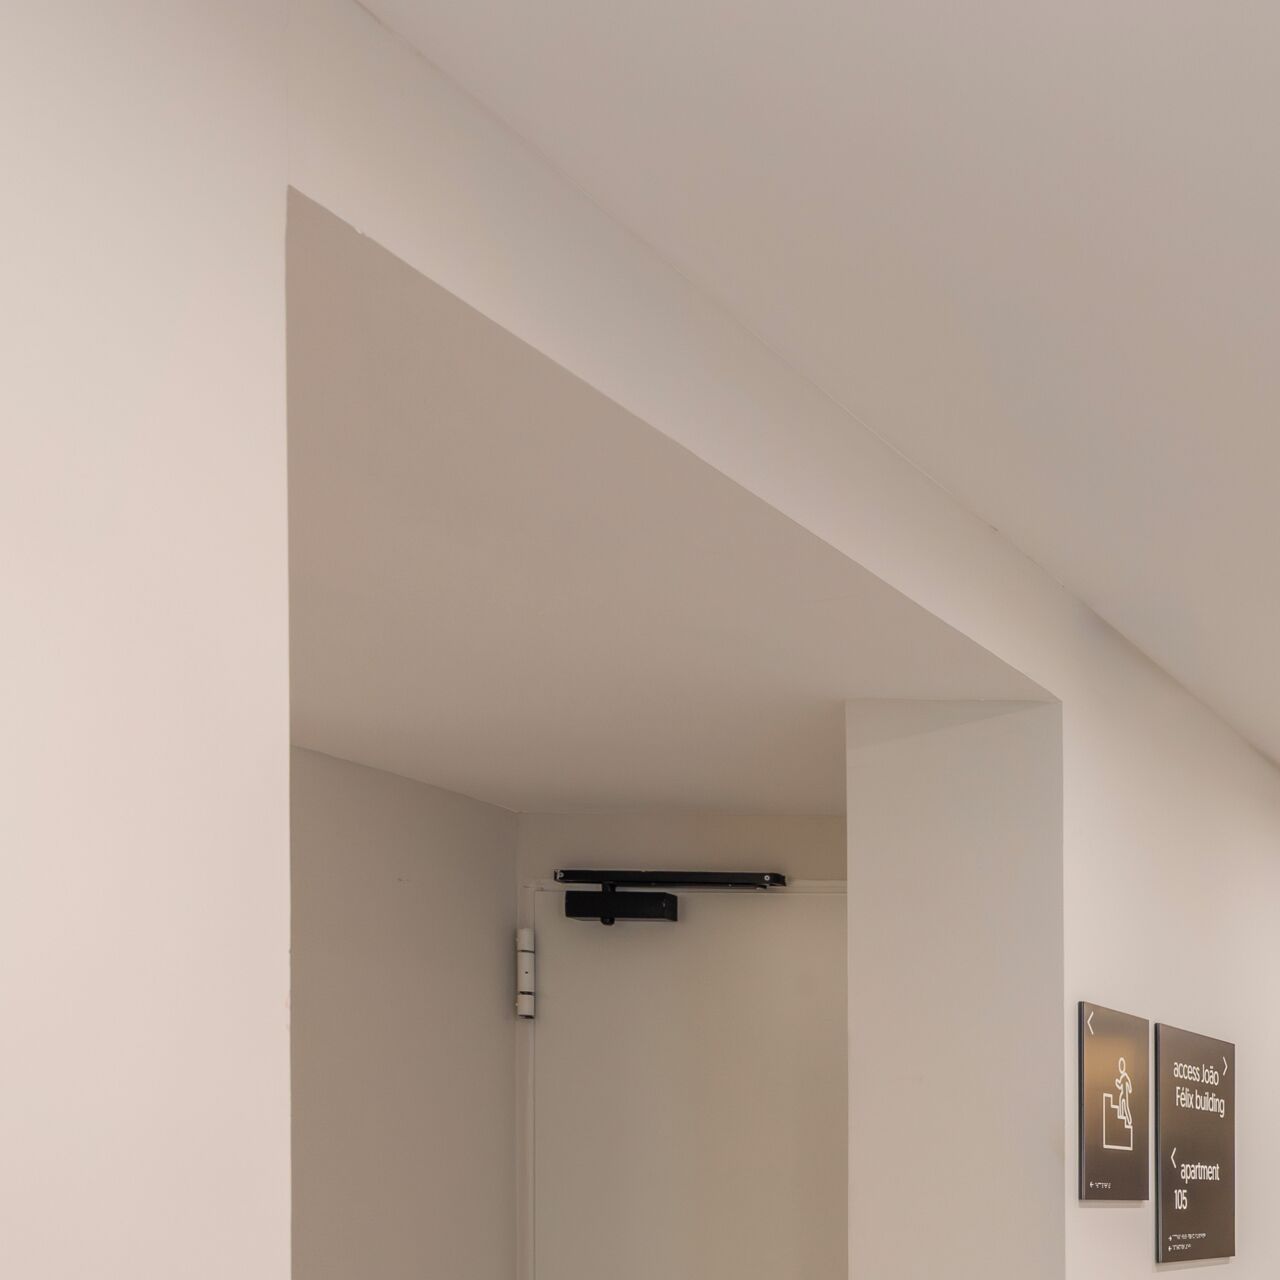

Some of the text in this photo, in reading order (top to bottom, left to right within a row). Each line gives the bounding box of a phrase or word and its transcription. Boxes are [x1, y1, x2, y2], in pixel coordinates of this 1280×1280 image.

[1173, 1061, 1219, 1085] access João
[1175, 1086, 1225, 1118] Félix building
[1180, 1162, 1220, 1184] apartment
[1174, 1189, 1188, 1210] 105
